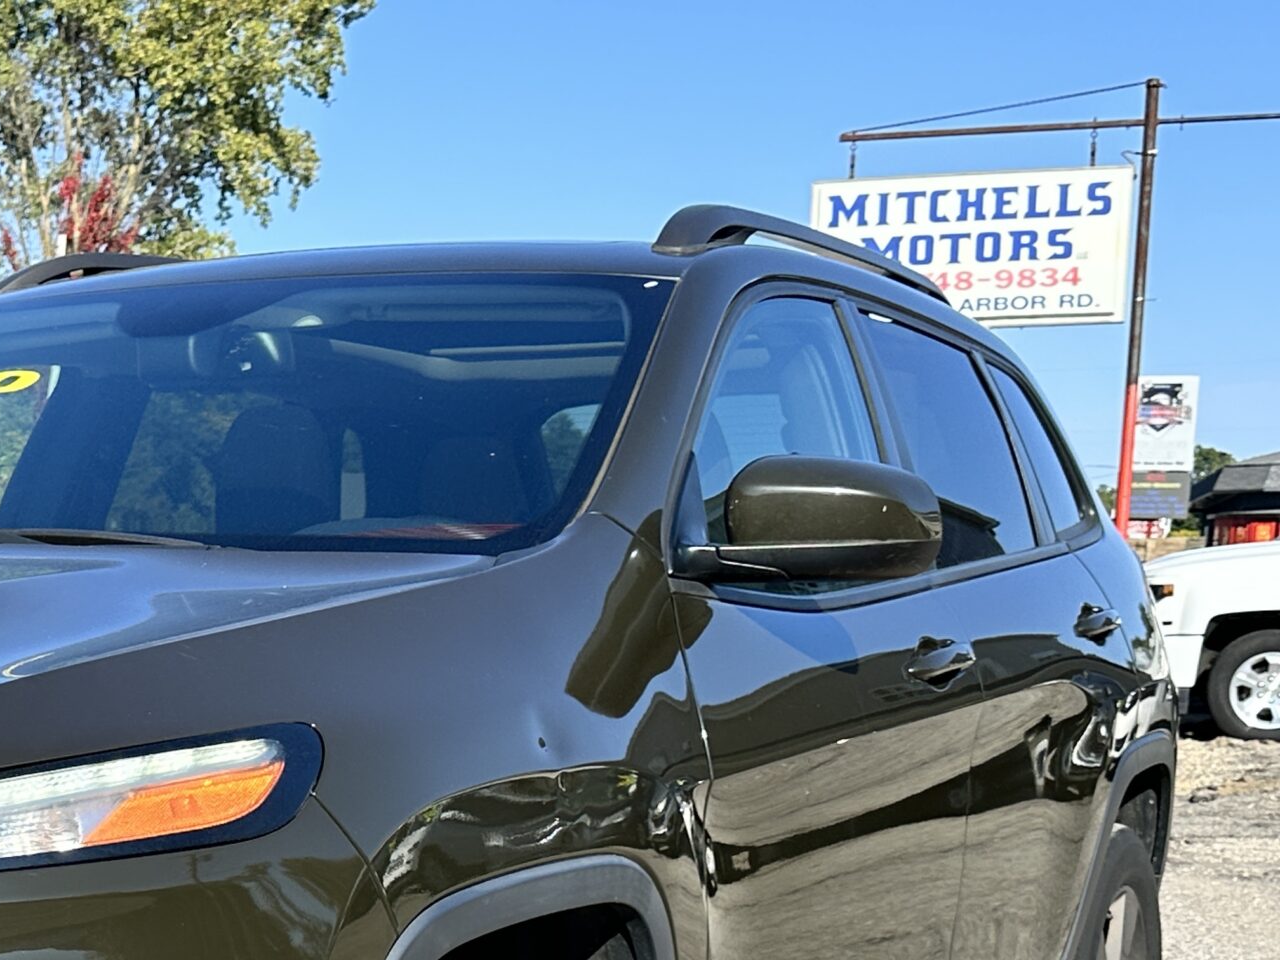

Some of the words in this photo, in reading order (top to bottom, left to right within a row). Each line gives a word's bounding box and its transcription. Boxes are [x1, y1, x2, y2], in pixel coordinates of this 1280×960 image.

[827, 181, 1113, 228] MITCHELLS
[860, 228, 1074, 266] MOTORS
[927, 266, 1082, 292] 48-9834
[958, 295, 1047, 313] ARBOR
[1059, 293, 1101, 309] RD.
